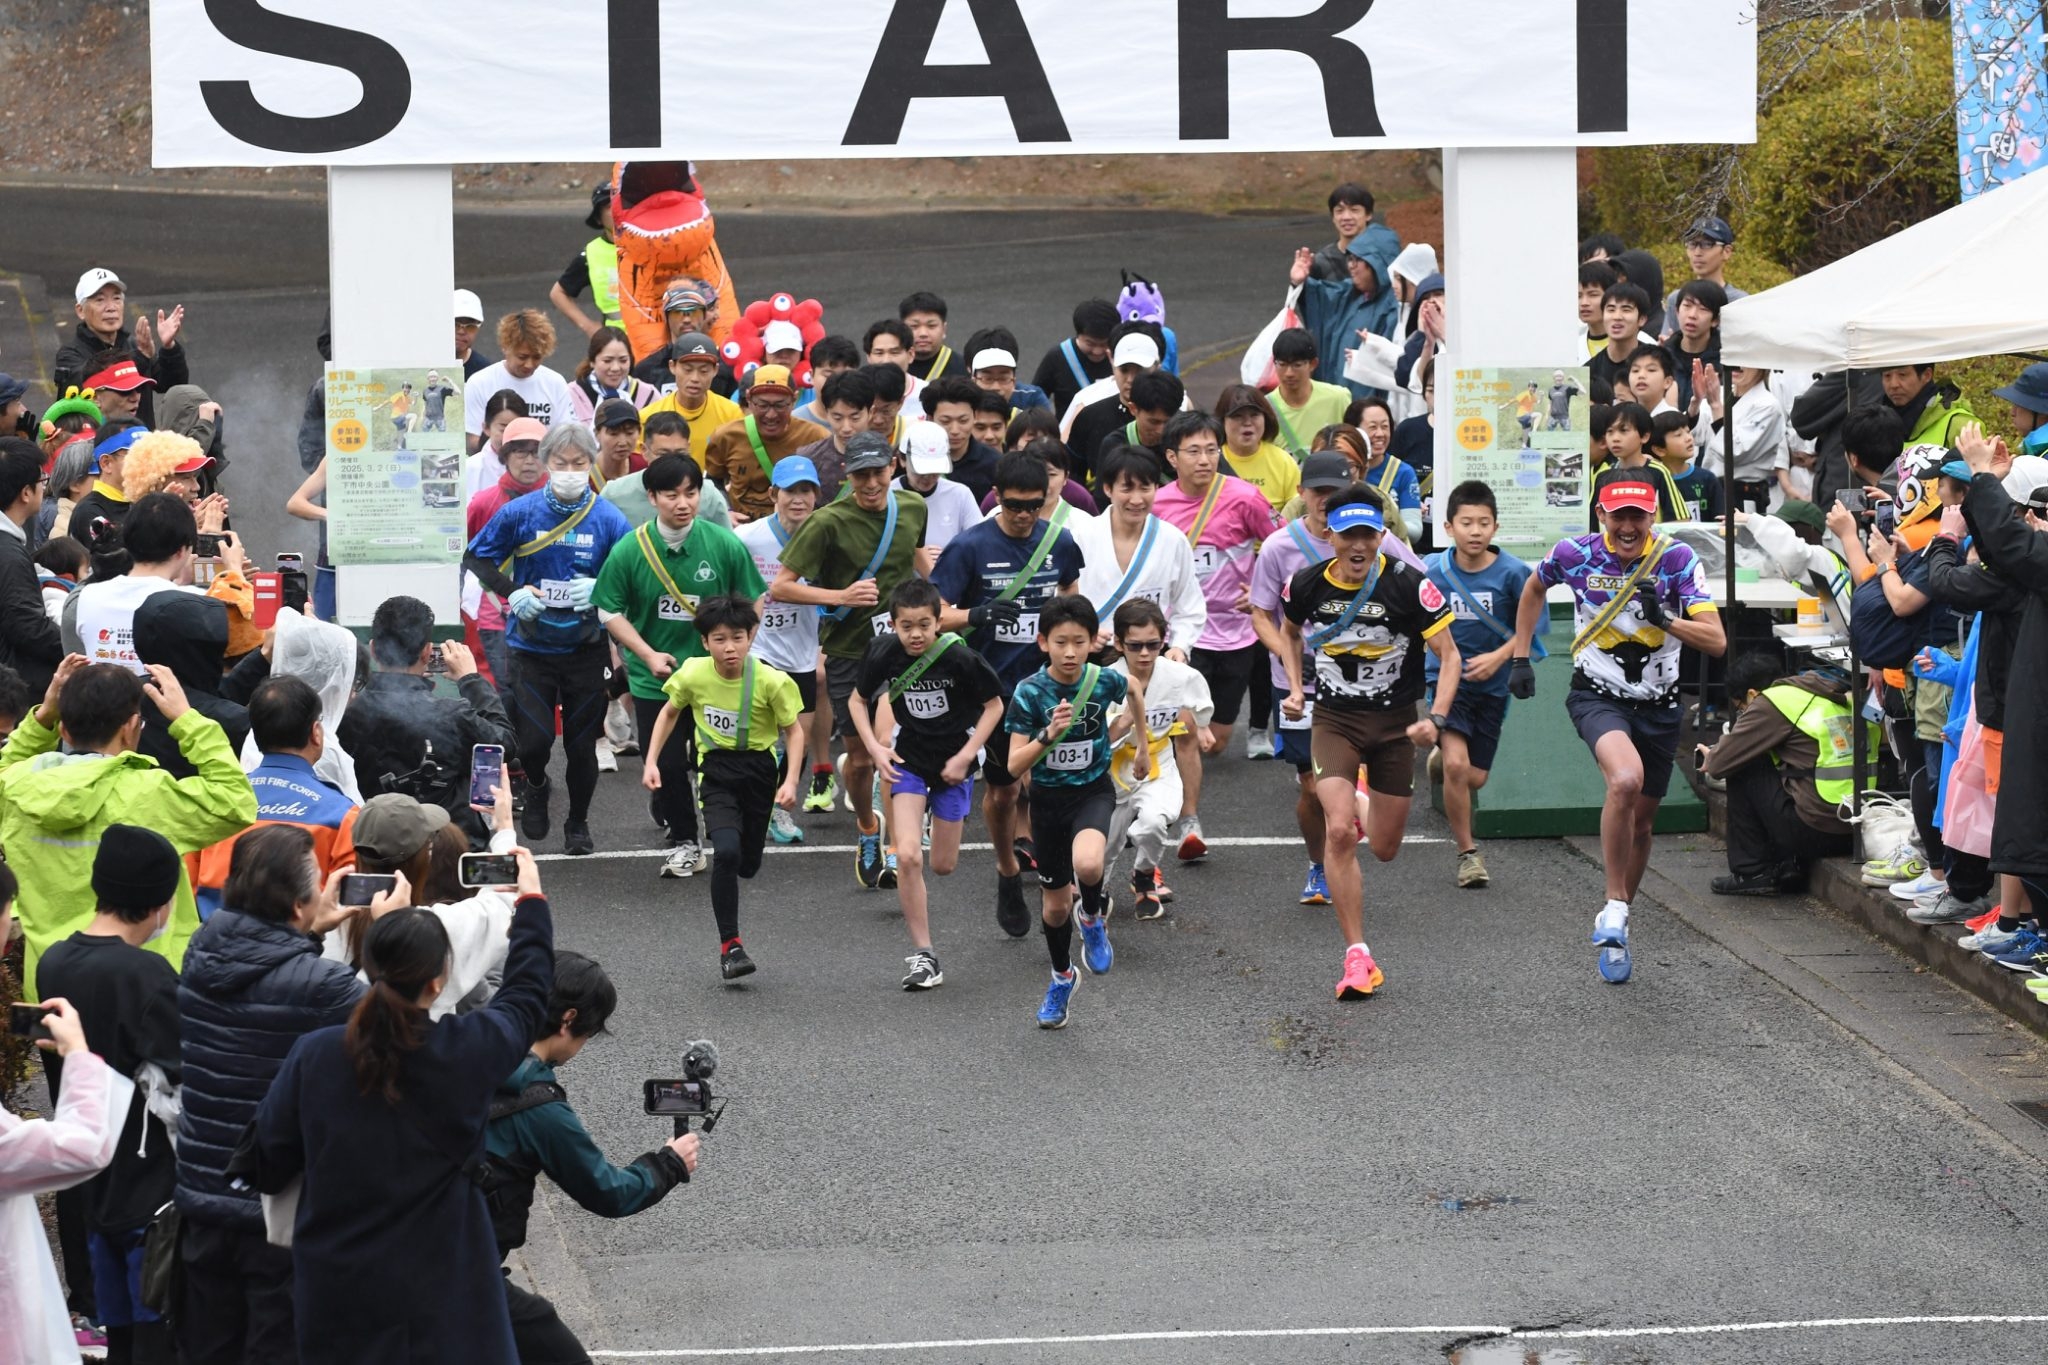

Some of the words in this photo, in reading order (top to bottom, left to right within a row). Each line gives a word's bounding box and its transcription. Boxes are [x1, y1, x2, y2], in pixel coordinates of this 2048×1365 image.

[328, 409, 355, 418] 2025
[1456, 407, 1482, 416] 2025
[343, 481, 390, 489] 下市中央公園
[1453, 600, 1490, 613] 113
[764, 612, 798, 628] 33-1
[998, 620, 1035, 636] 30-1
[1362, 661, 1397, 680] 2-4
[907, 695, 945, 712] 101-3
[706, 713, 739, 730] 120-
[1051, 747, 1089, 764] 103-1
[267, 776, 290, 788] FIRE
[289, 783, 322, 802] CORPS
[257, 801, 308, 816] oichi
